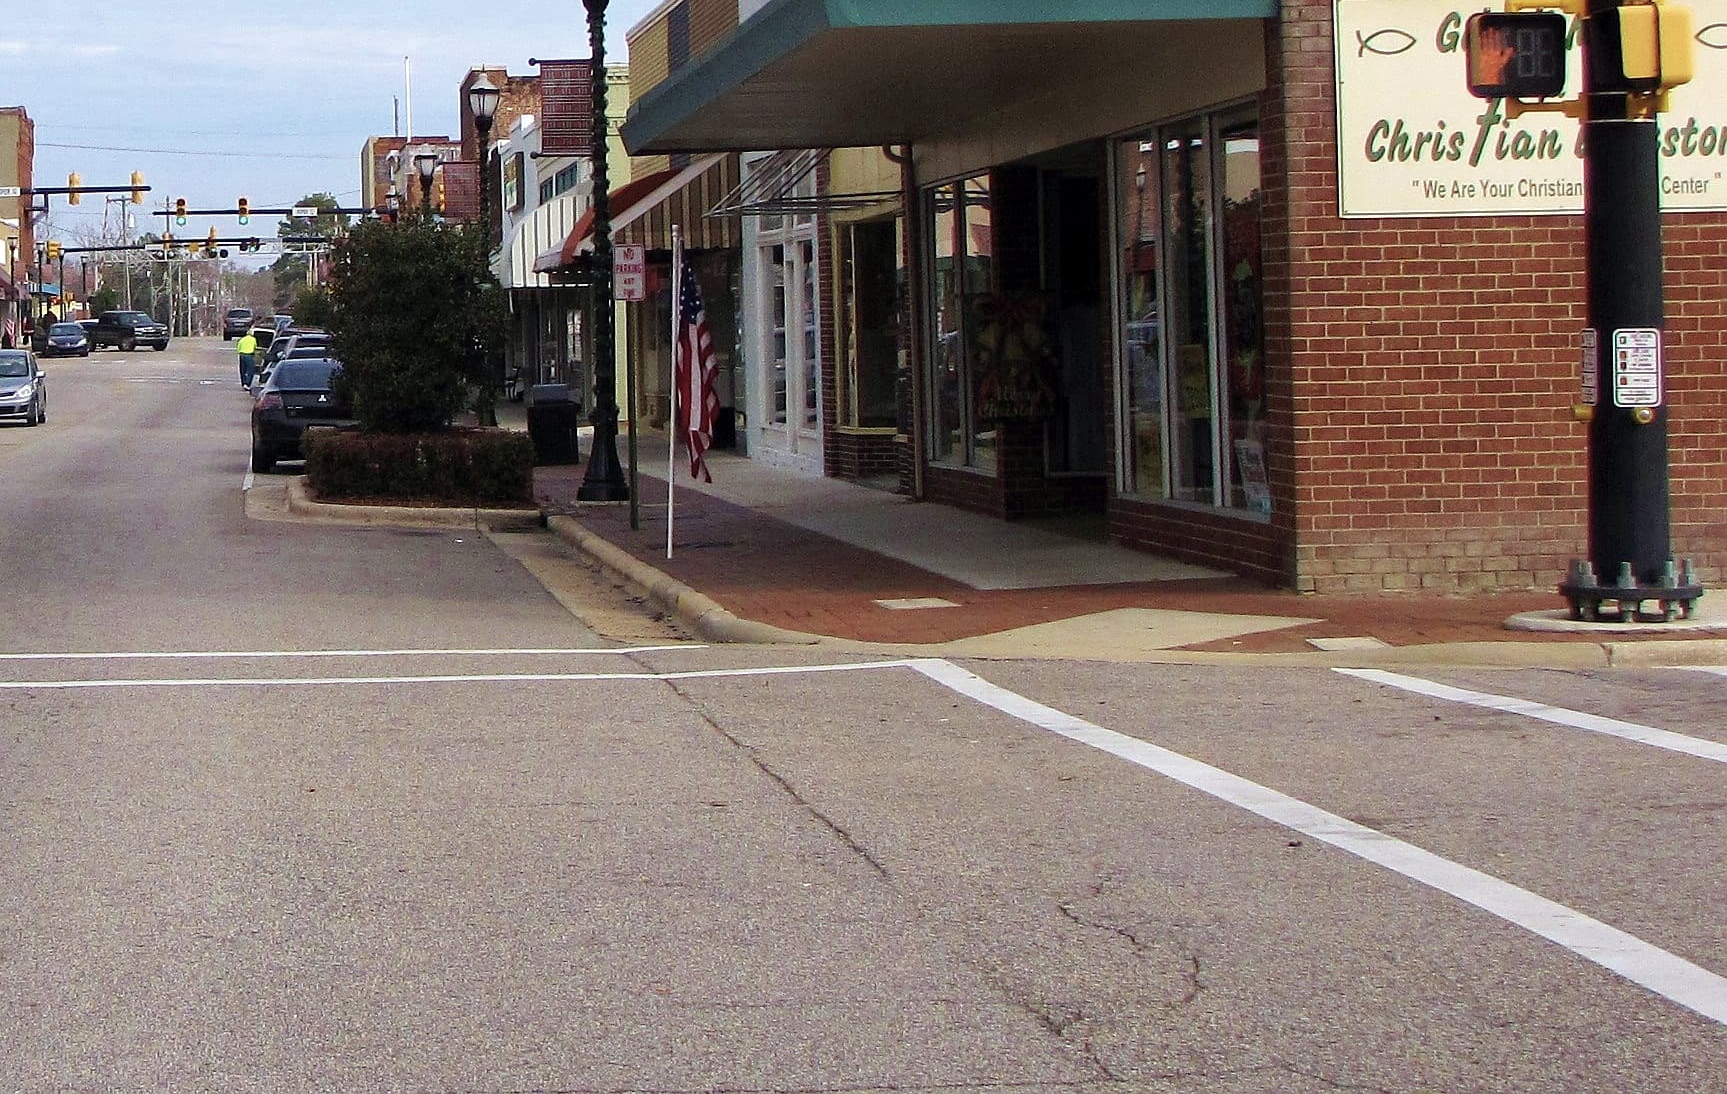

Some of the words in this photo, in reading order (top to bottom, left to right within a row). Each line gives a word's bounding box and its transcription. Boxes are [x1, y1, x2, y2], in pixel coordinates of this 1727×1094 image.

[1423, 179, 1446, 198] We
[1450, 179, 1476, 198] Are
[1479, 178, 1514, 198] Your
[1518, 177, 1584, 198] Christian
[1661, 175, 1710, 194] Center
[623, 248, 635, 260] NO
[616, 263, 642, 273] PARKING
